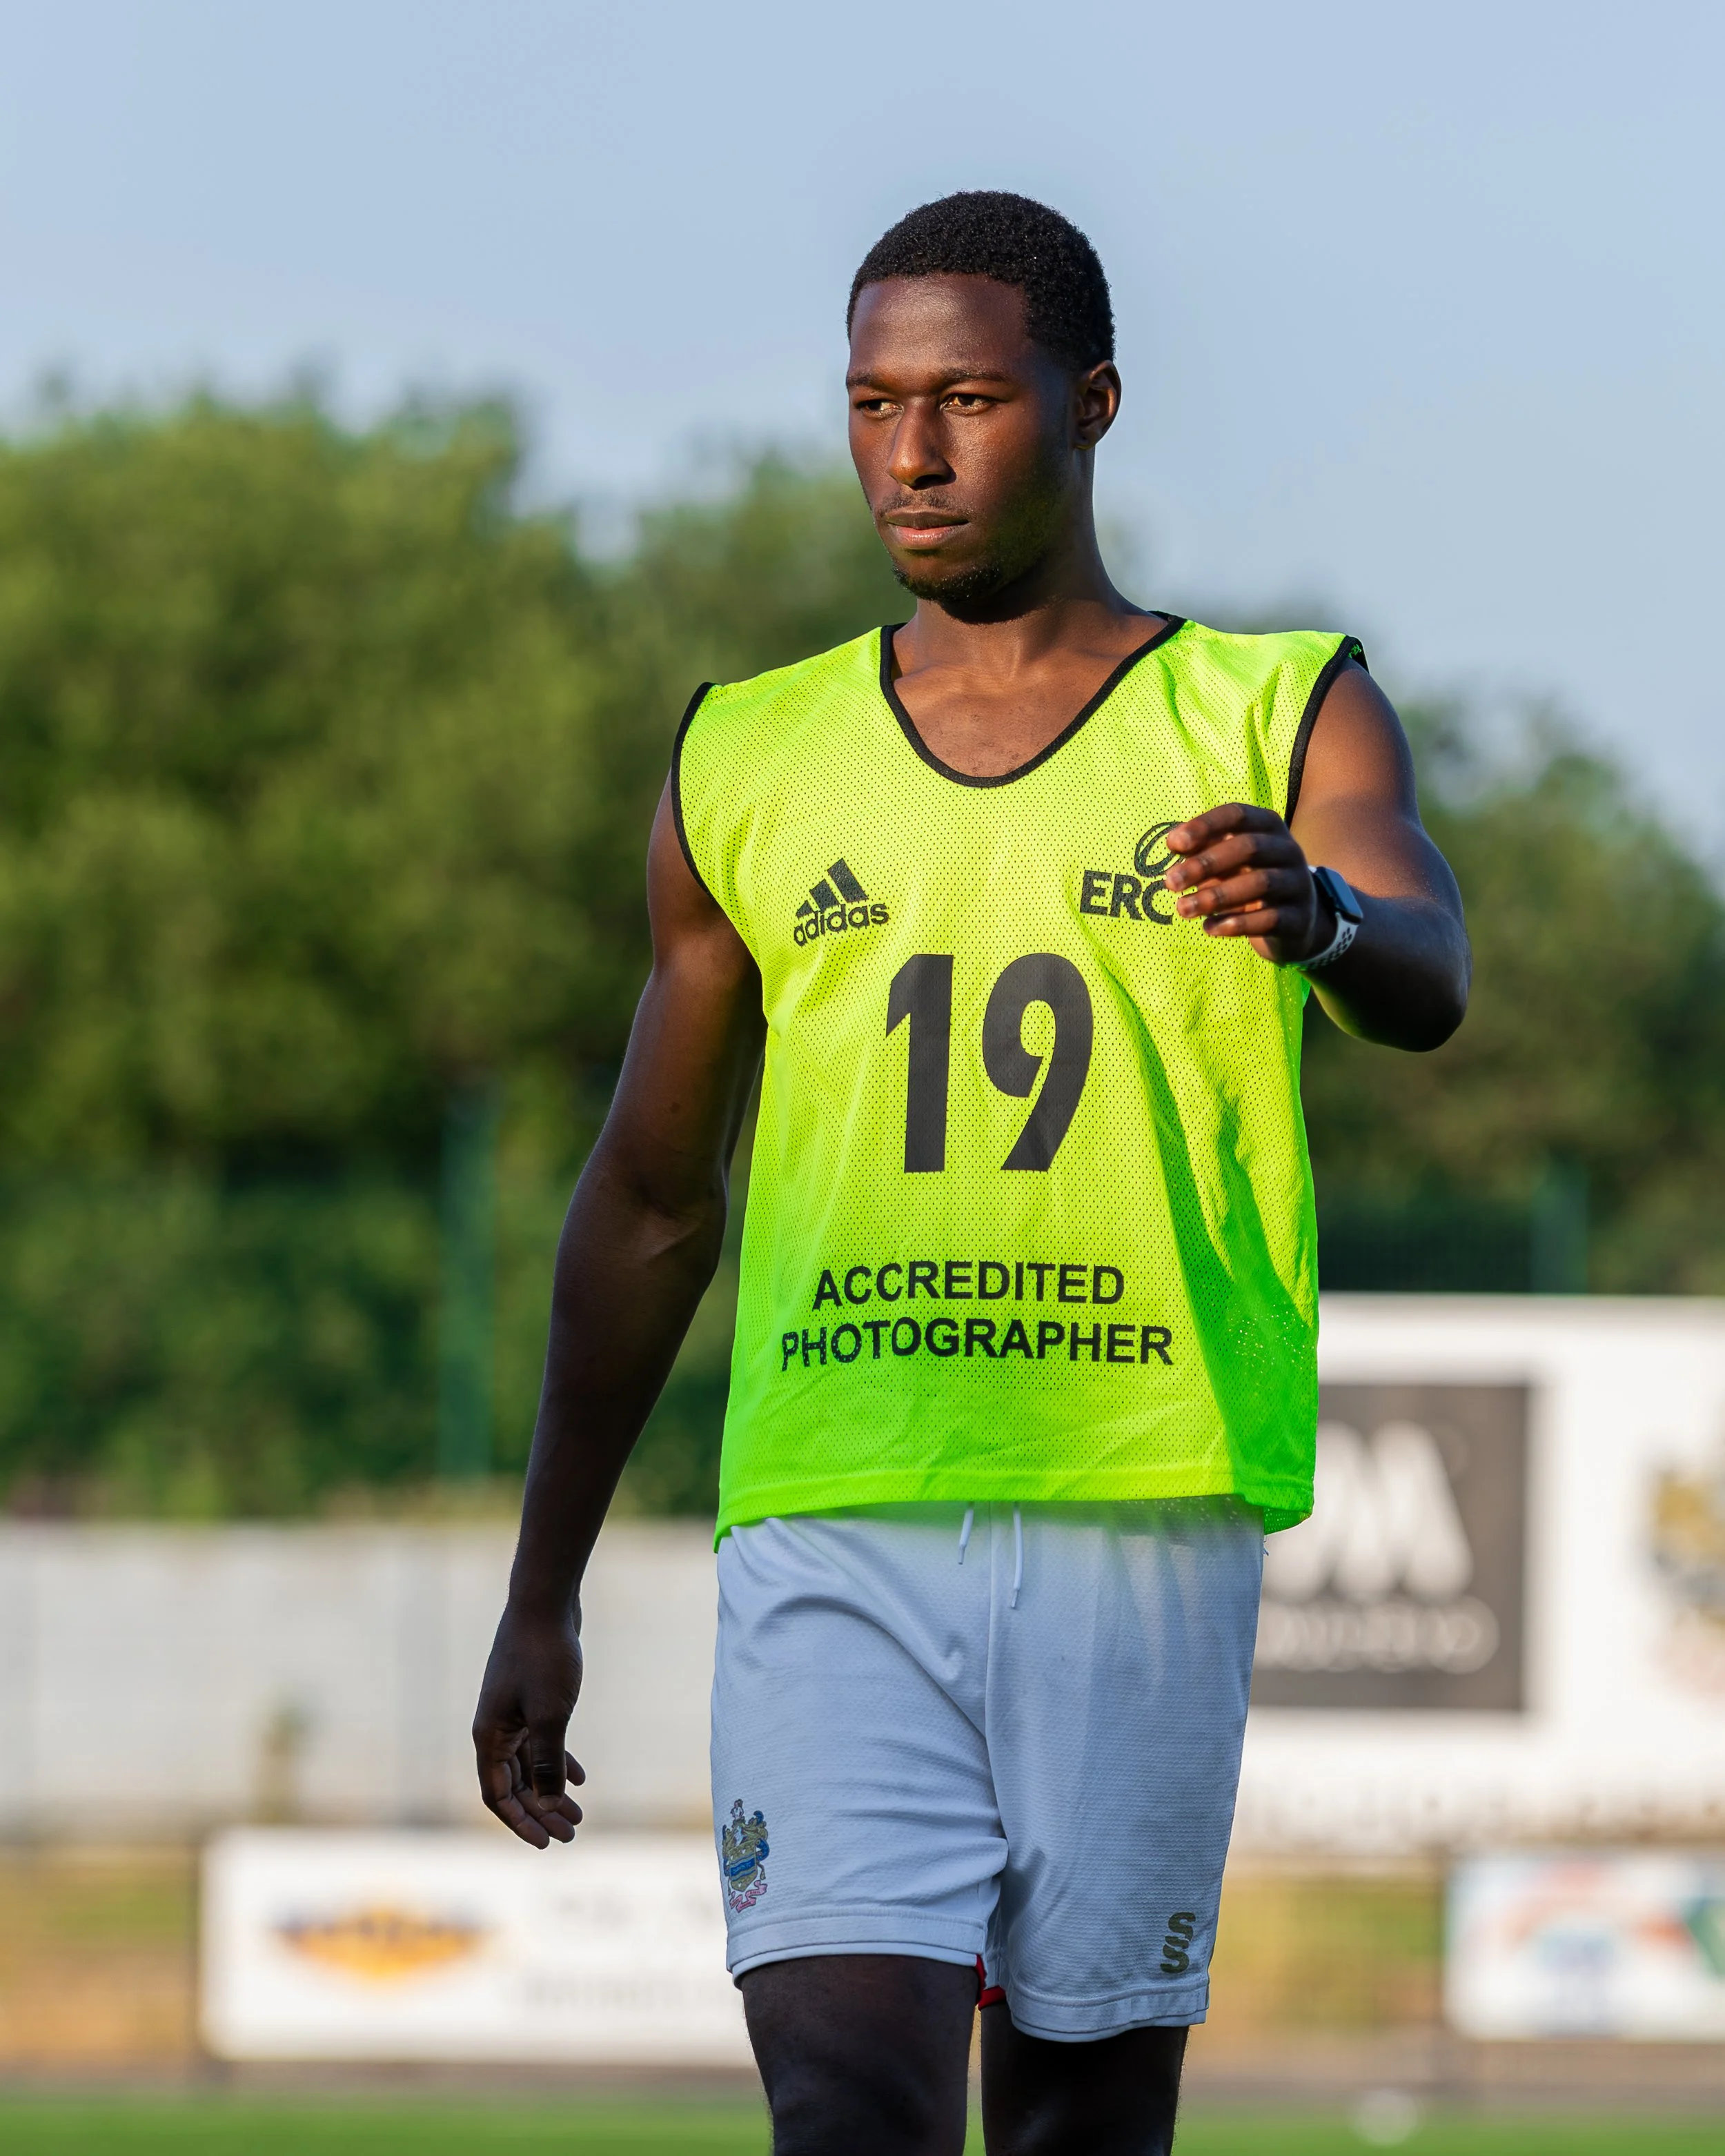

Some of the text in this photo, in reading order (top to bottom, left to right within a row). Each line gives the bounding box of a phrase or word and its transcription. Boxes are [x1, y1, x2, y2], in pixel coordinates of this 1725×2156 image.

[793, 903, 890, 947] adidas
[886, 953, 1094, 1173] 19
[812, 1260, 1125, 1311] ACCREDITED
[781, 1316, 1174, 1372] PHOTOGRAPHER
